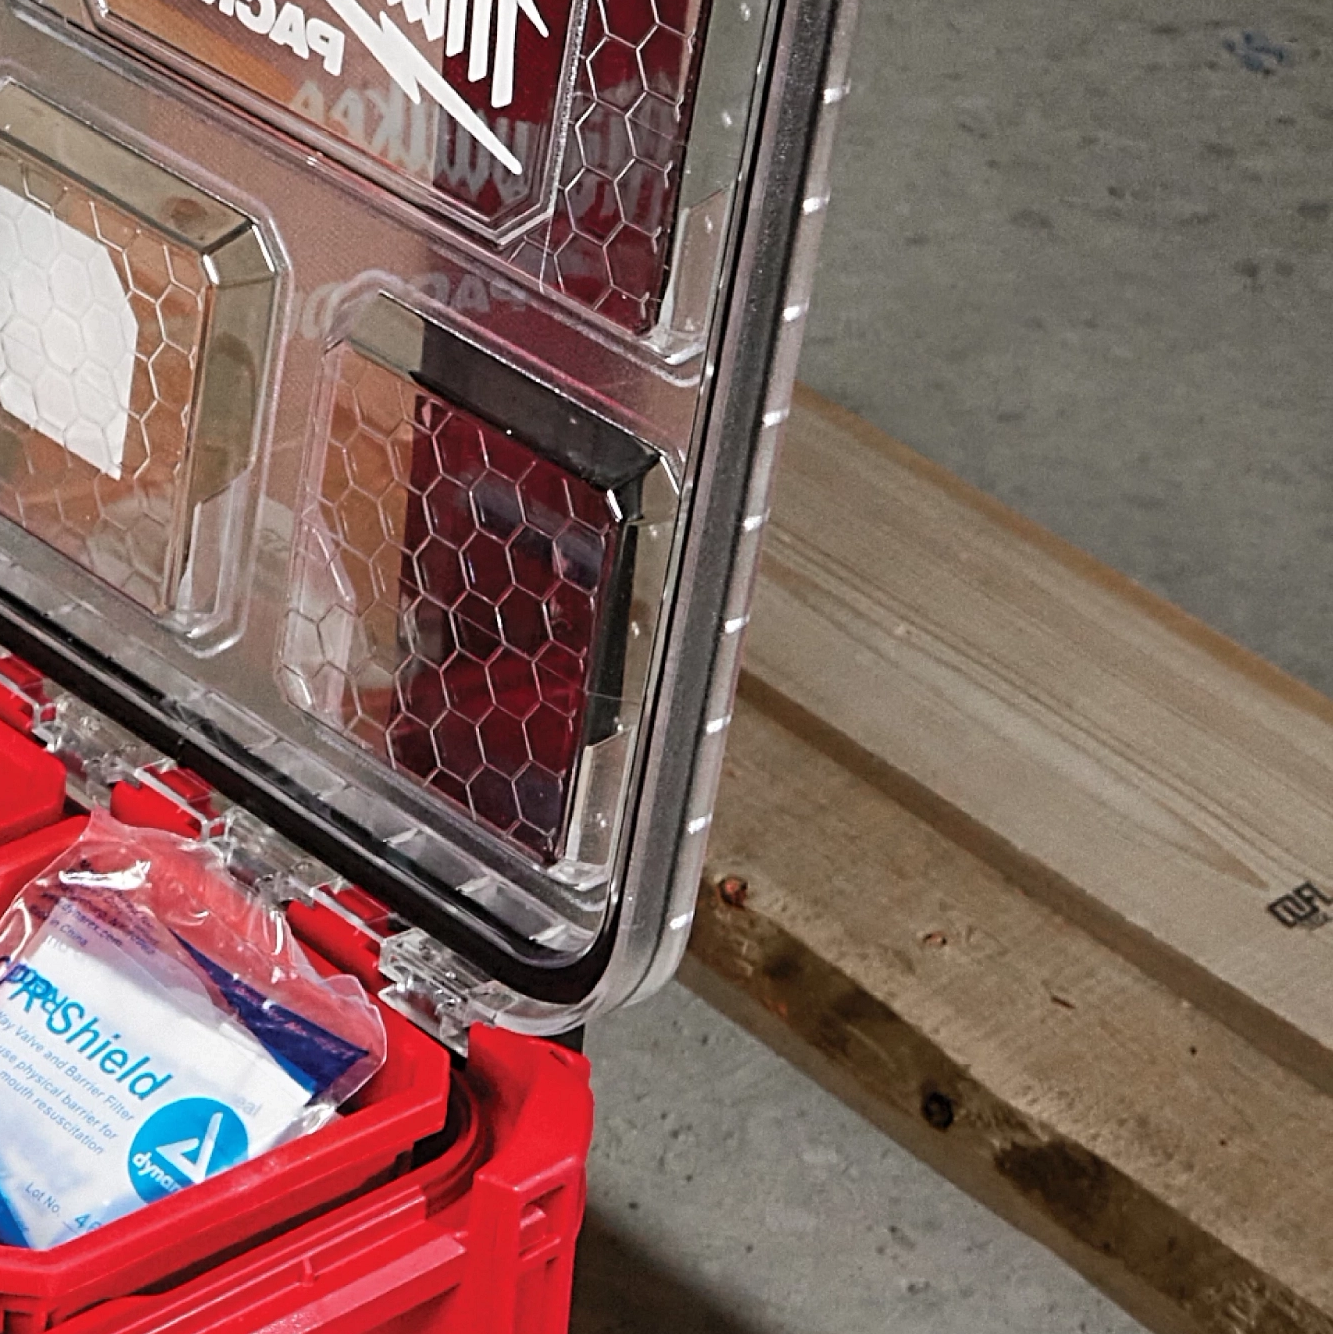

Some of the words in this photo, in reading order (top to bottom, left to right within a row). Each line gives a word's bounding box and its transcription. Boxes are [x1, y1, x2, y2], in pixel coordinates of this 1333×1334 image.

[14, 1025, 44, 1053] Valve
[44, 1048, 69, 1070] and
[64, 1065, 106, 1099] Barrier
[102, 1093, 135, 1122] Filter
[15, 1060, 63, 1099] physical
[61, 1091, 101, 1128] barrier
[99, 1122, 119, 1141] for
[32, 1095, 105, 1155] resuscitation
[24, 1182, 43, 1203] Lot
